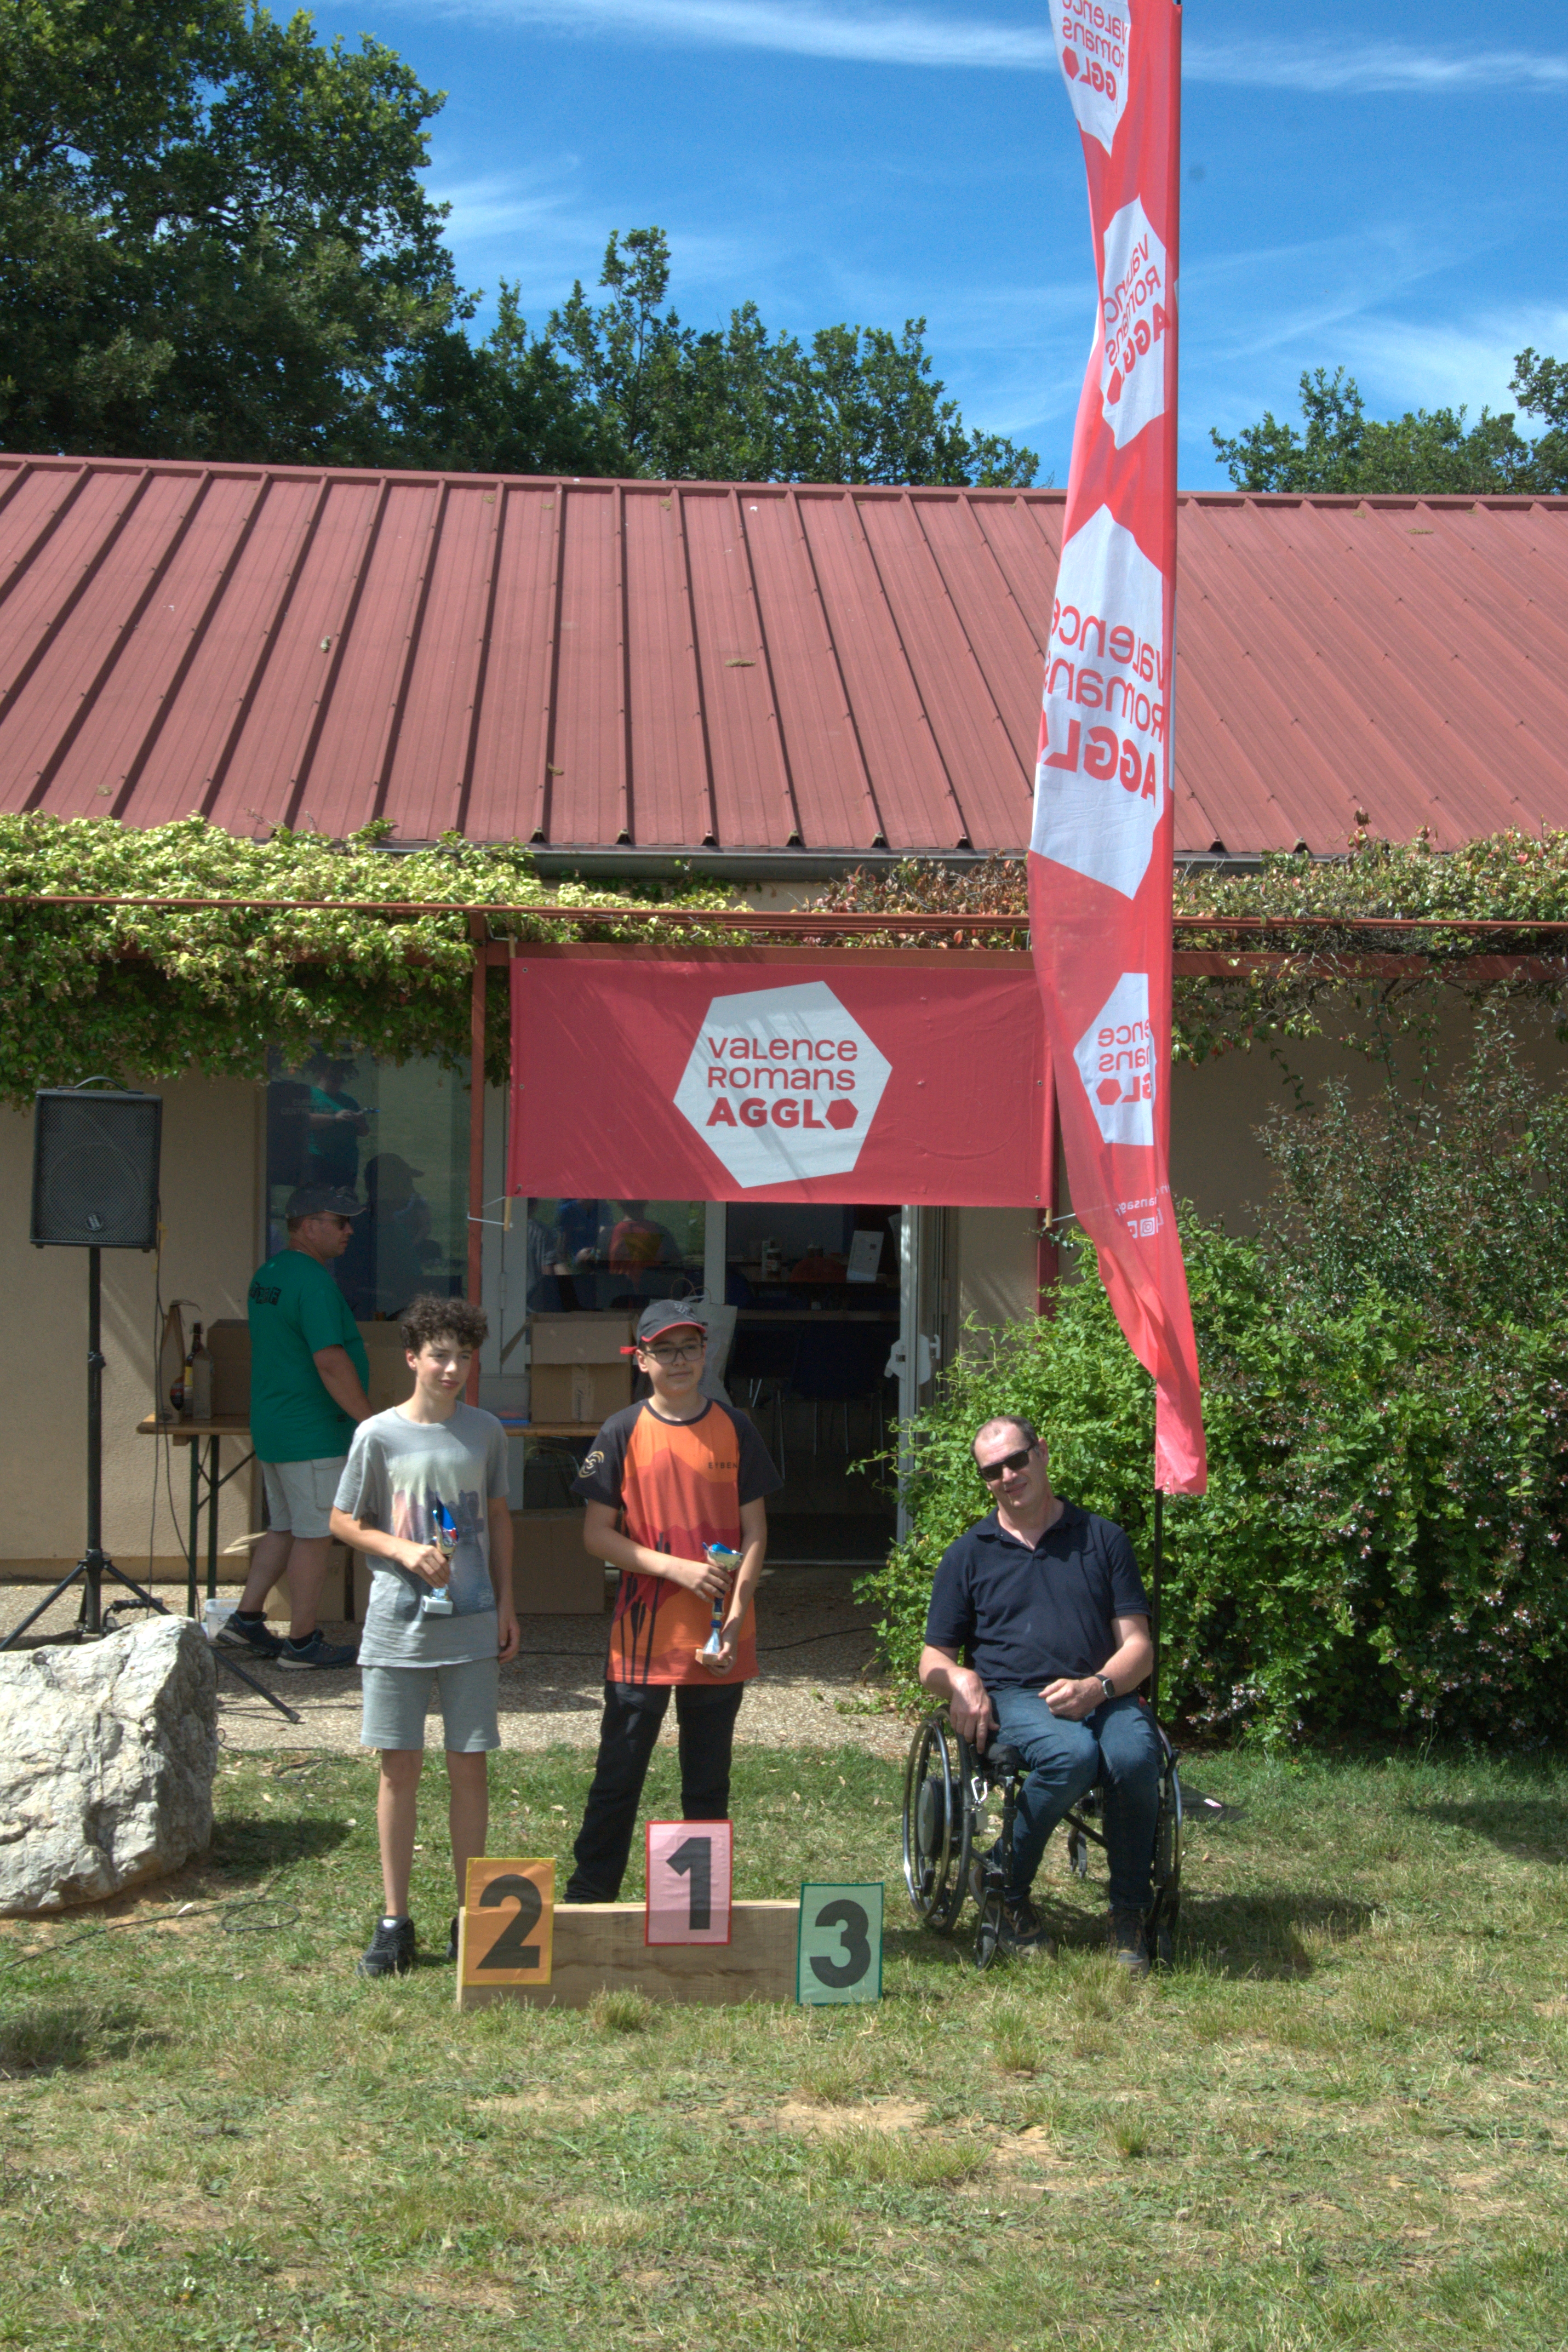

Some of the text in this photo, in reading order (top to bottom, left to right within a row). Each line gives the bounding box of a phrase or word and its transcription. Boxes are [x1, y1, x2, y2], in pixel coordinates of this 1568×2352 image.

[708, 1066, 855, 1090] Romans
[476, 1874, 542, 1970] 2
[666, 1837, 711, 1930] 1
[810, 1899, 871, 1988] 3
